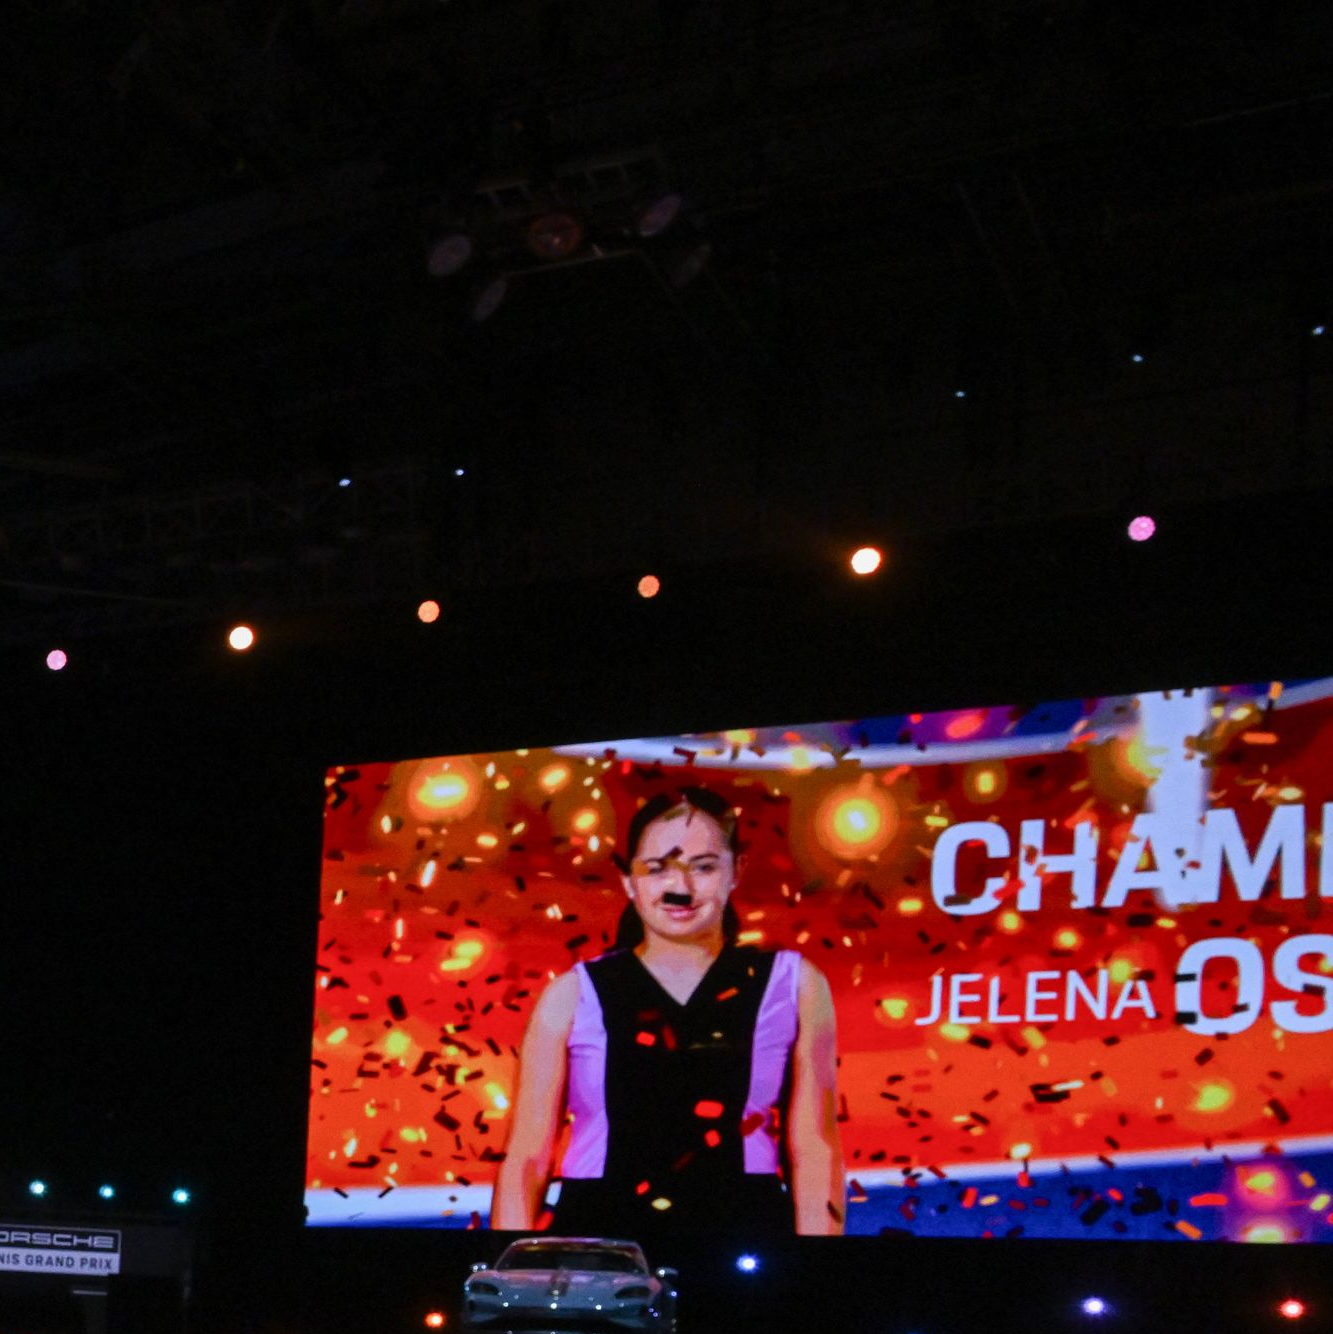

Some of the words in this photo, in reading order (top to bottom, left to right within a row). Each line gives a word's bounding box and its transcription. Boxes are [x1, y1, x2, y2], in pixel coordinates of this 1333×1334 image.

[931, 802, 1333, 917] CHAM
[914, 968, 1158, 1026] JELENA
[1174, 933, 1333, 1036] OS
[24, 1254, 75, 1267] GRAND
[79, 1257, 113, 1270] PRIX
